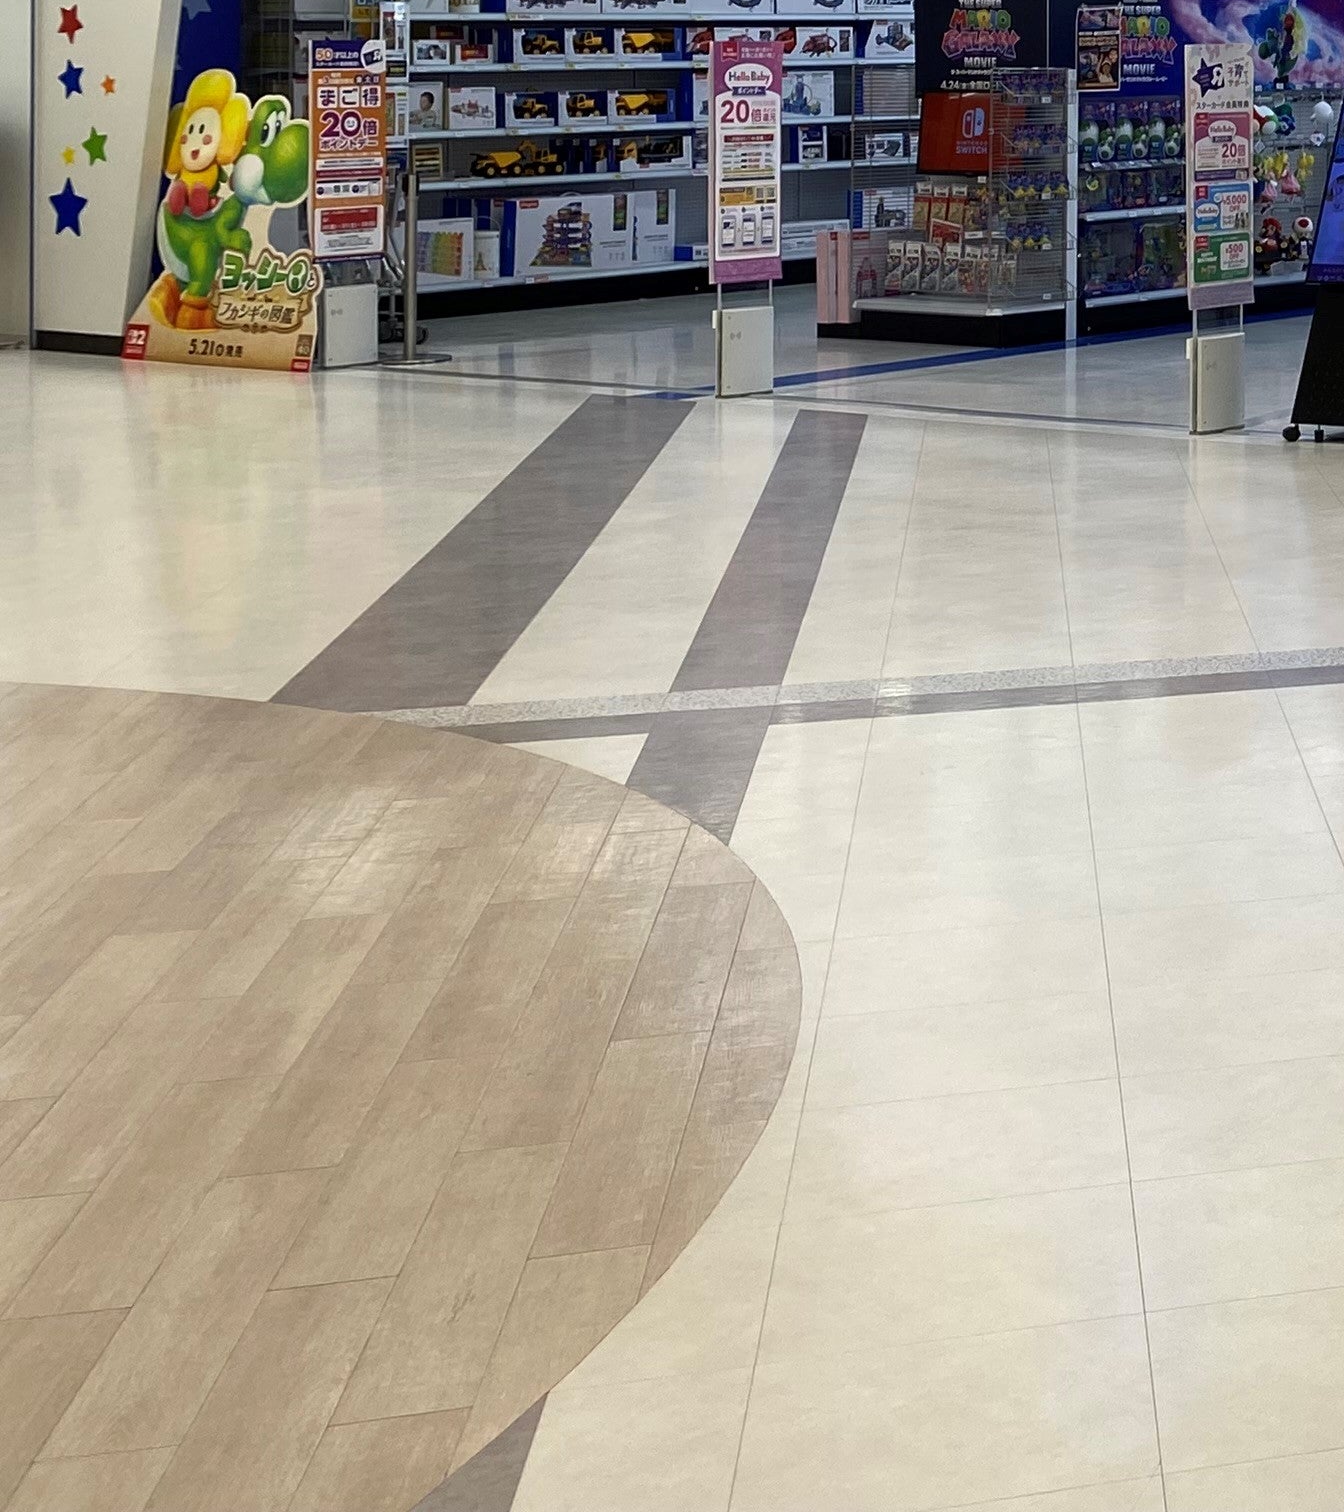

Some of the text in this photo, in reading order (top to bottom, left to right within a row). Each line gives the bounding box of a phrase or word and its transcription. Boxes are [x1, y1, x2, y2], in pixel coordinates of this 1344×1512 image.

[1135, 5, 1161, 14] SUPER
[950, 9, 1012, 31] MARIO
[1121, 36, 1178, 65] ALAXY
[964, 57, 997, 67] MOVIE
[1123, 64, 1155, 74] MOVIE
[729, 71, 771, 85] Hello Baby
[317, 85, 381, 109] まご得
[320, 110, 379, 138] 20倍
[321, 138, 378, 150] ポイントデー
[956, 145, 988, 154] SWITCH
[219, 302, 296, 325] フカシギの図鑑
